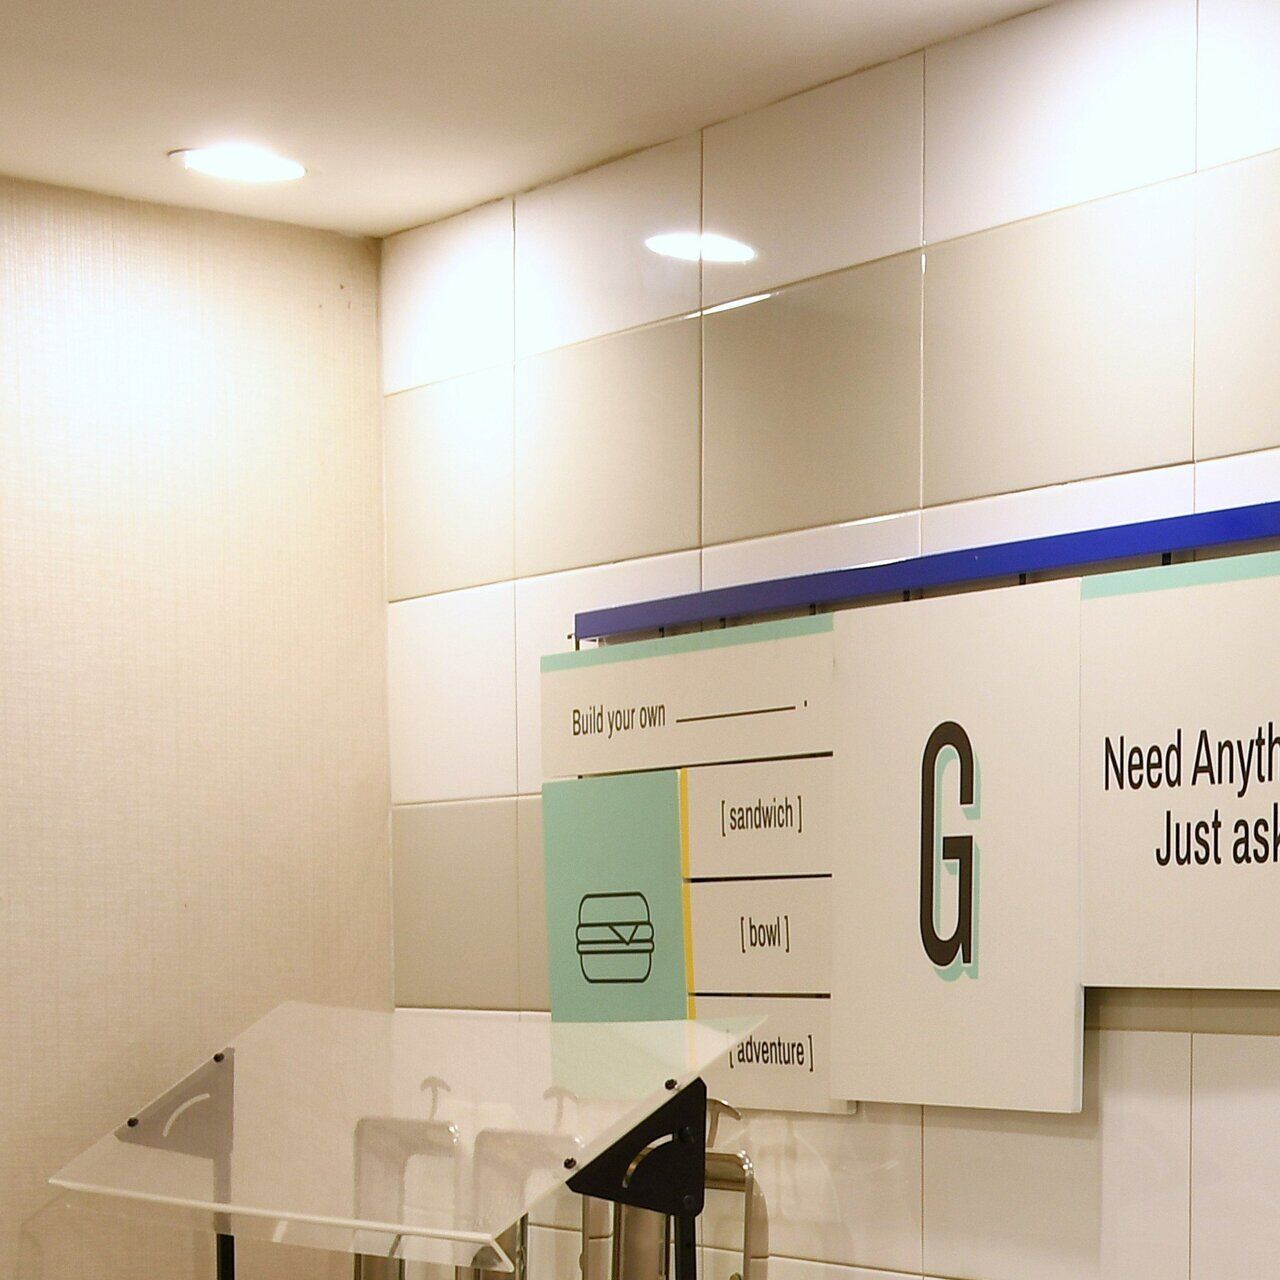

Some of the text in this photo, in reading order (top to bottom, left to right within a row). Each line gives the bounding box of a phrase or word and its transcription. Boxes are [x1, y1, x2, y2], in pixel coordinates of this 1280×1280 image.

[572, 703, 666, 739] Build your own
[1104, 728, 1182, 791] Need
[919, 720, 980, 981] G
[1155, 808, 1222, 866] Just
